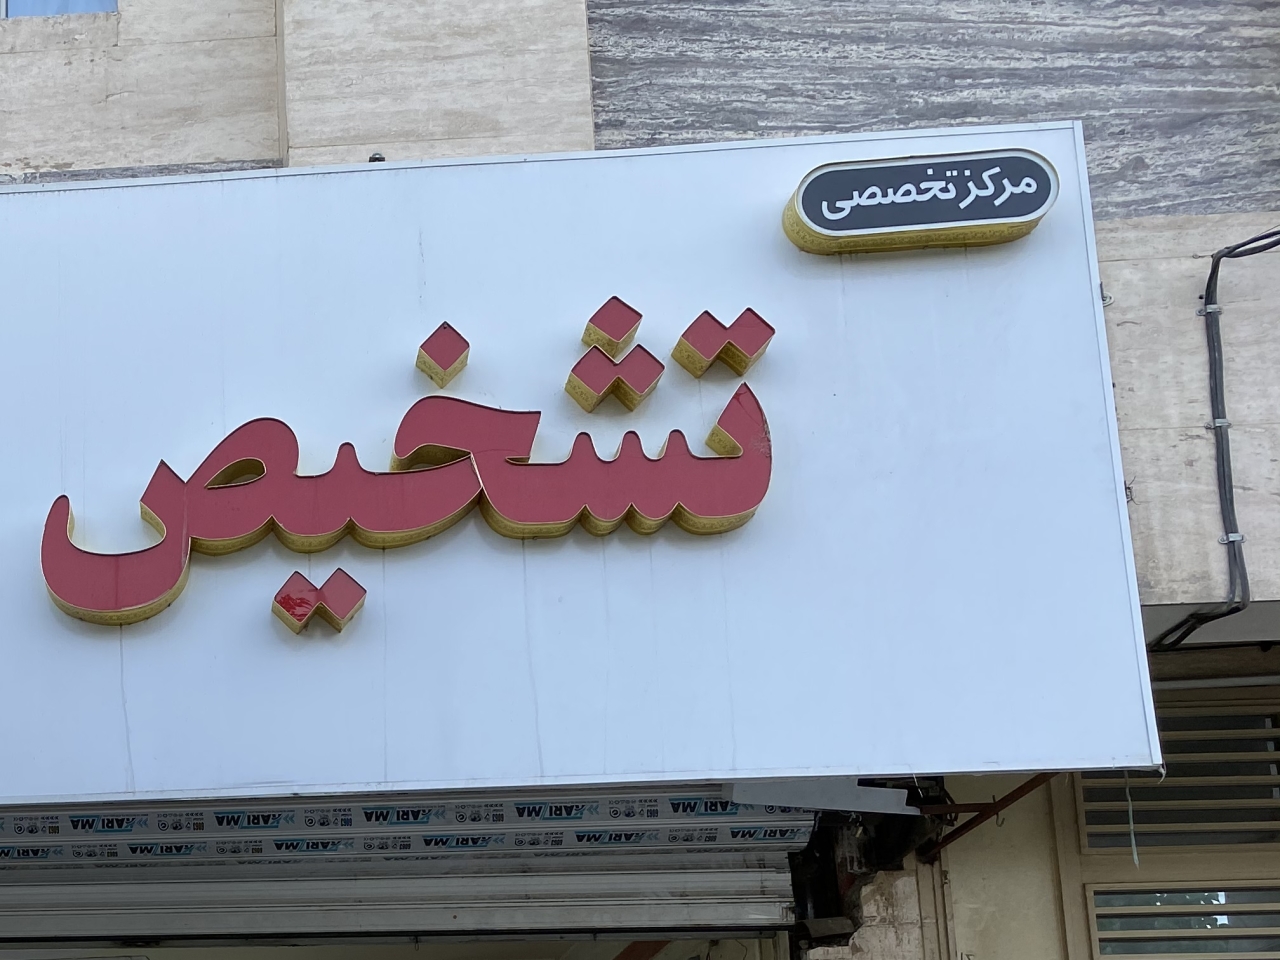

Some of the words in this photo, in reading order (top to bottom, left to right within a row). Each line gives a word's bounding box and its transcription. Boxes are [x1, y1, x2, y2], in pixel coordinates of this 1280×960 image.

[820, 168, 957, 221] تخصصی
[958, 165, 1039, 209] مرکز
[40, 295, 776, 633] تشخیص
